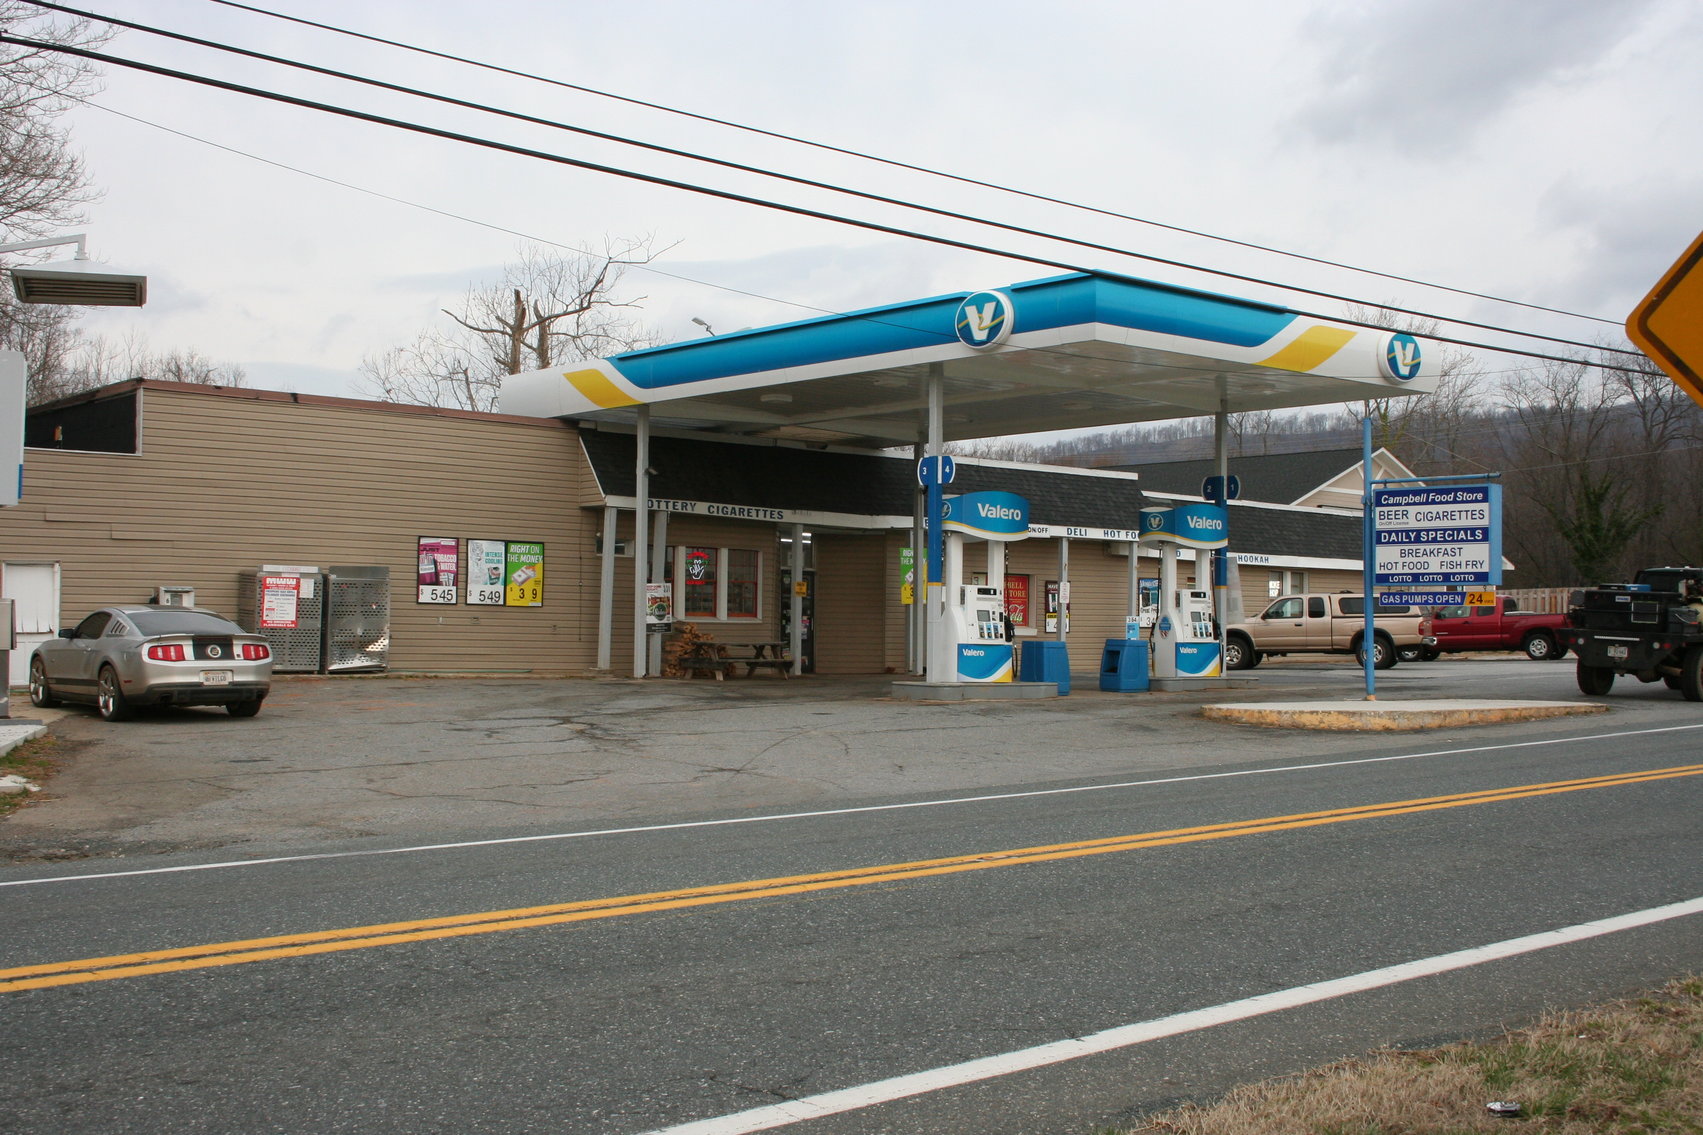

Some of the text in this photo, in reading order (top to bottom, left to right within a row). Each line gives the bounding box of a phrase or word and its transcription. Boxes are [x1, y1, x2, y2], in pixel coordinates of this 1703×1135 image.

[922, 467, 928, 475] 3
[944, 465, 950, 473] 4
[1207, 485, 1212, 493] 2
[1381, 491, 1483, 505] Campbell Food Store
[648, 499, 697, 512] OTTERY
[707, 504, 784, 520] CIGARETTES
[977, 502, 1021, 521] Valero
[1378, 509, 1485, 522] BEER CIGARETTES
[1187, 515, 1223, 530] Valero
[1066, 527, 1088, 537] DELI
[1103, 530, 1121, 538] HOT
[1381, 529, 1483, 543] DAILY SPECIALS
[510, 544, 540, 554] RIGHT ON
[1400, 547, 1463, 558] BREAKFAST
[434, 553, 457, 563] TOBACCO
[507, 553, 543, 563] THE MONEY
[1236, 555, 1269, 564] HOOKAH
[1379, 560, 1485, 571] HOT FOOD FISH FRY
[1420, 574, 1443, 582] LOTTO
[1381, 595, 1400, 604] GAS
[1402, 594, 1434, 603] PUMPS
[1435, 594, 1461, 603] OPEN
[1468, 593, 1484, 604] 24
[962, 648, 985, 656] Valero
[1179, 646, 1198, 654] Valero
